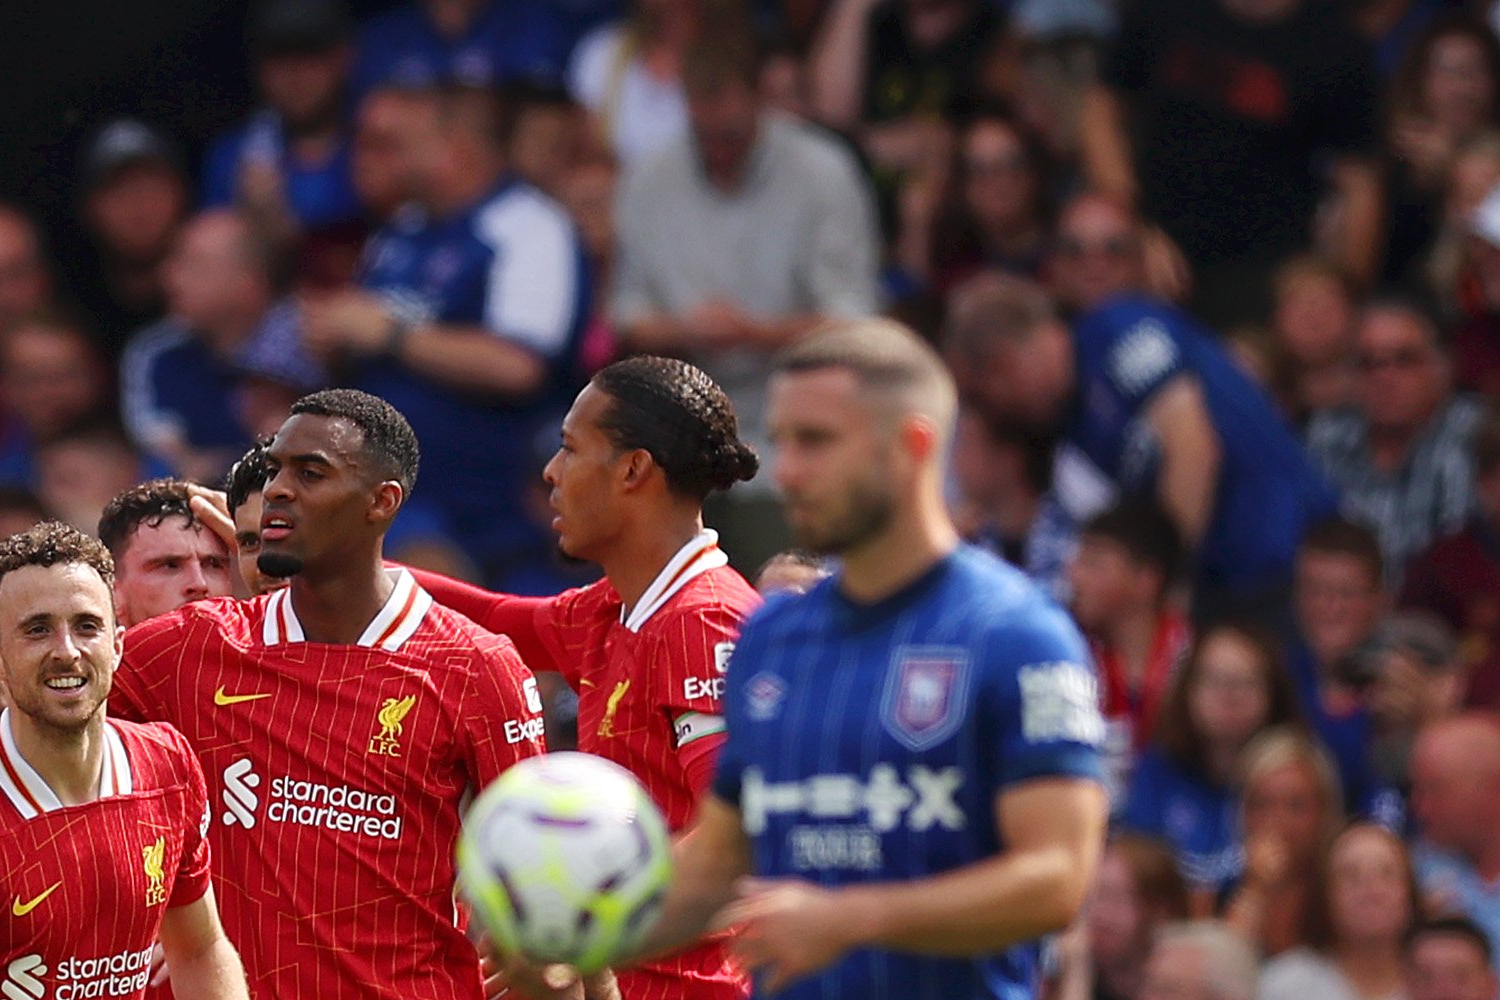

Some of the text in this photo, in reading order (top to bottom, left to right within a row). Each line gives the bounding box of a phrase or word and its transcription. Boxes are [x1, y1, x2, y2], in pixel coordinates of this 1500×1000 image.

[368, 739, 401, 757] LFC
[271, 775, 395, 815] standard
[268, 799, 401, 840] chartered
[146, 889, 167, 908] LFC
